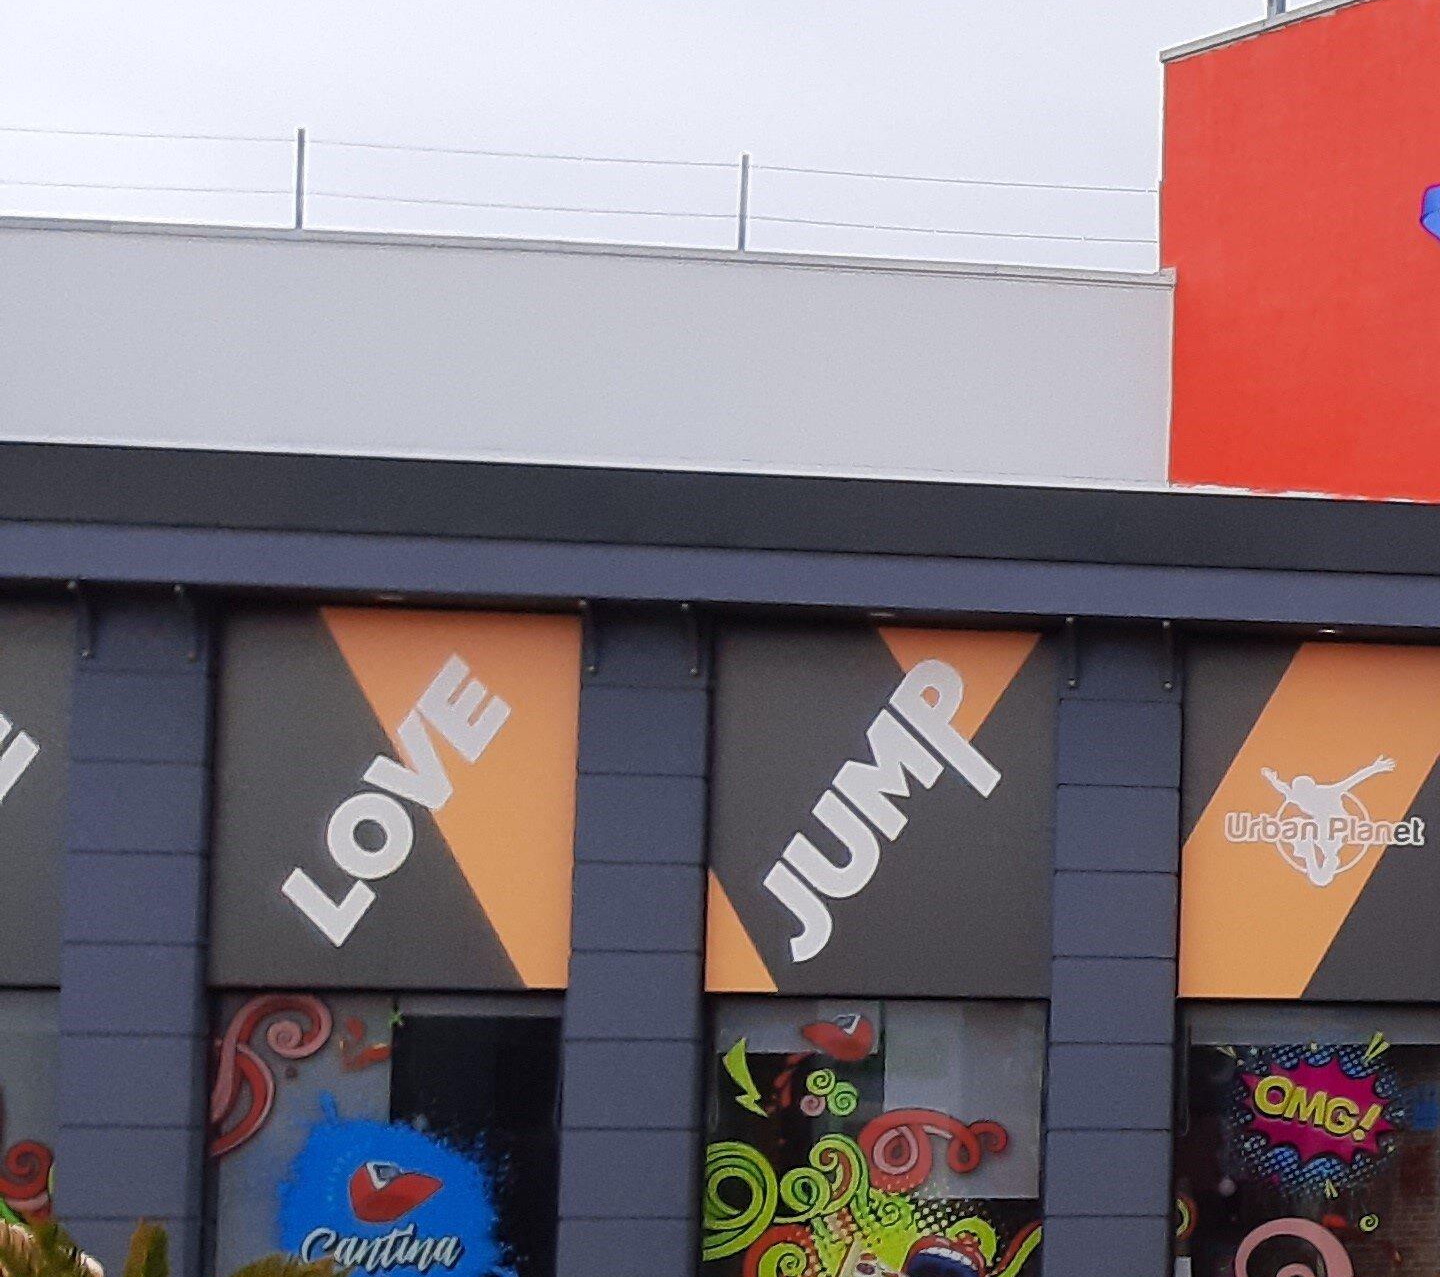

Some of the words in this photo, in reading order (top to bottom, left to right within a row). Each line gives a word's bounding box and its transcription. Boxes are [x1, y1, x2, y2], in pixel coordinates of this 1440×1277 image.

[281, 654, 512, 947] LOVE
[763, 658, 1002, 962] JUMP
[1225, 812, 1320, 842] Urban
[1327, 815, 1426, 847] Planet
[1253, 1074, 1383, 1142] OMG!
[302, 1223, 466, 1274] Cantina
